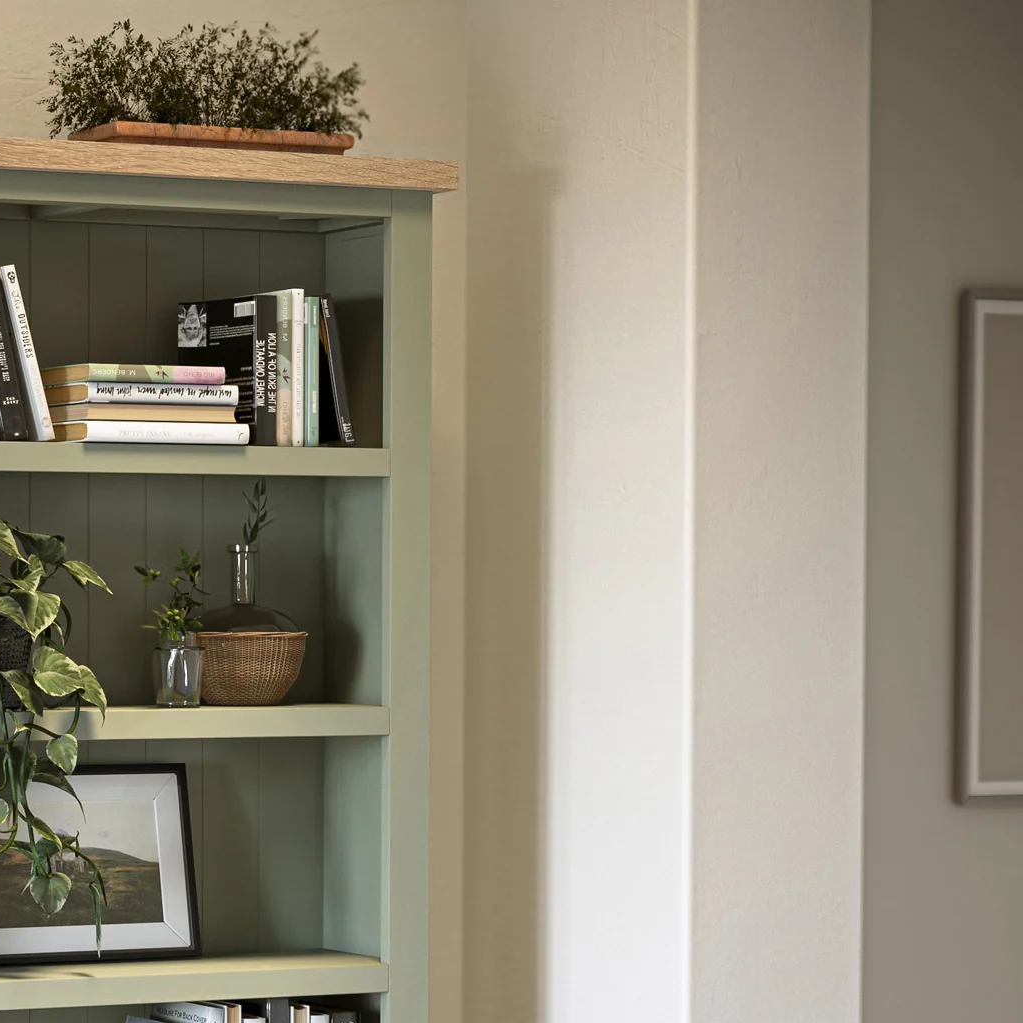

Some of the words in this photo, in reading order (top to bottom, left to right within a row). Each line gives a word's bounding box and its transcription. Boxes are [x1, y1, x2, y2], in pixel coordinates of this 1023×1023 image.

[18, 313, 34, 359] OUTSIDERS
[117, 385, 133, 397] John
[183, 1011, 193, 1020] BACK
[194, 1014, 207, 1023] COVER
